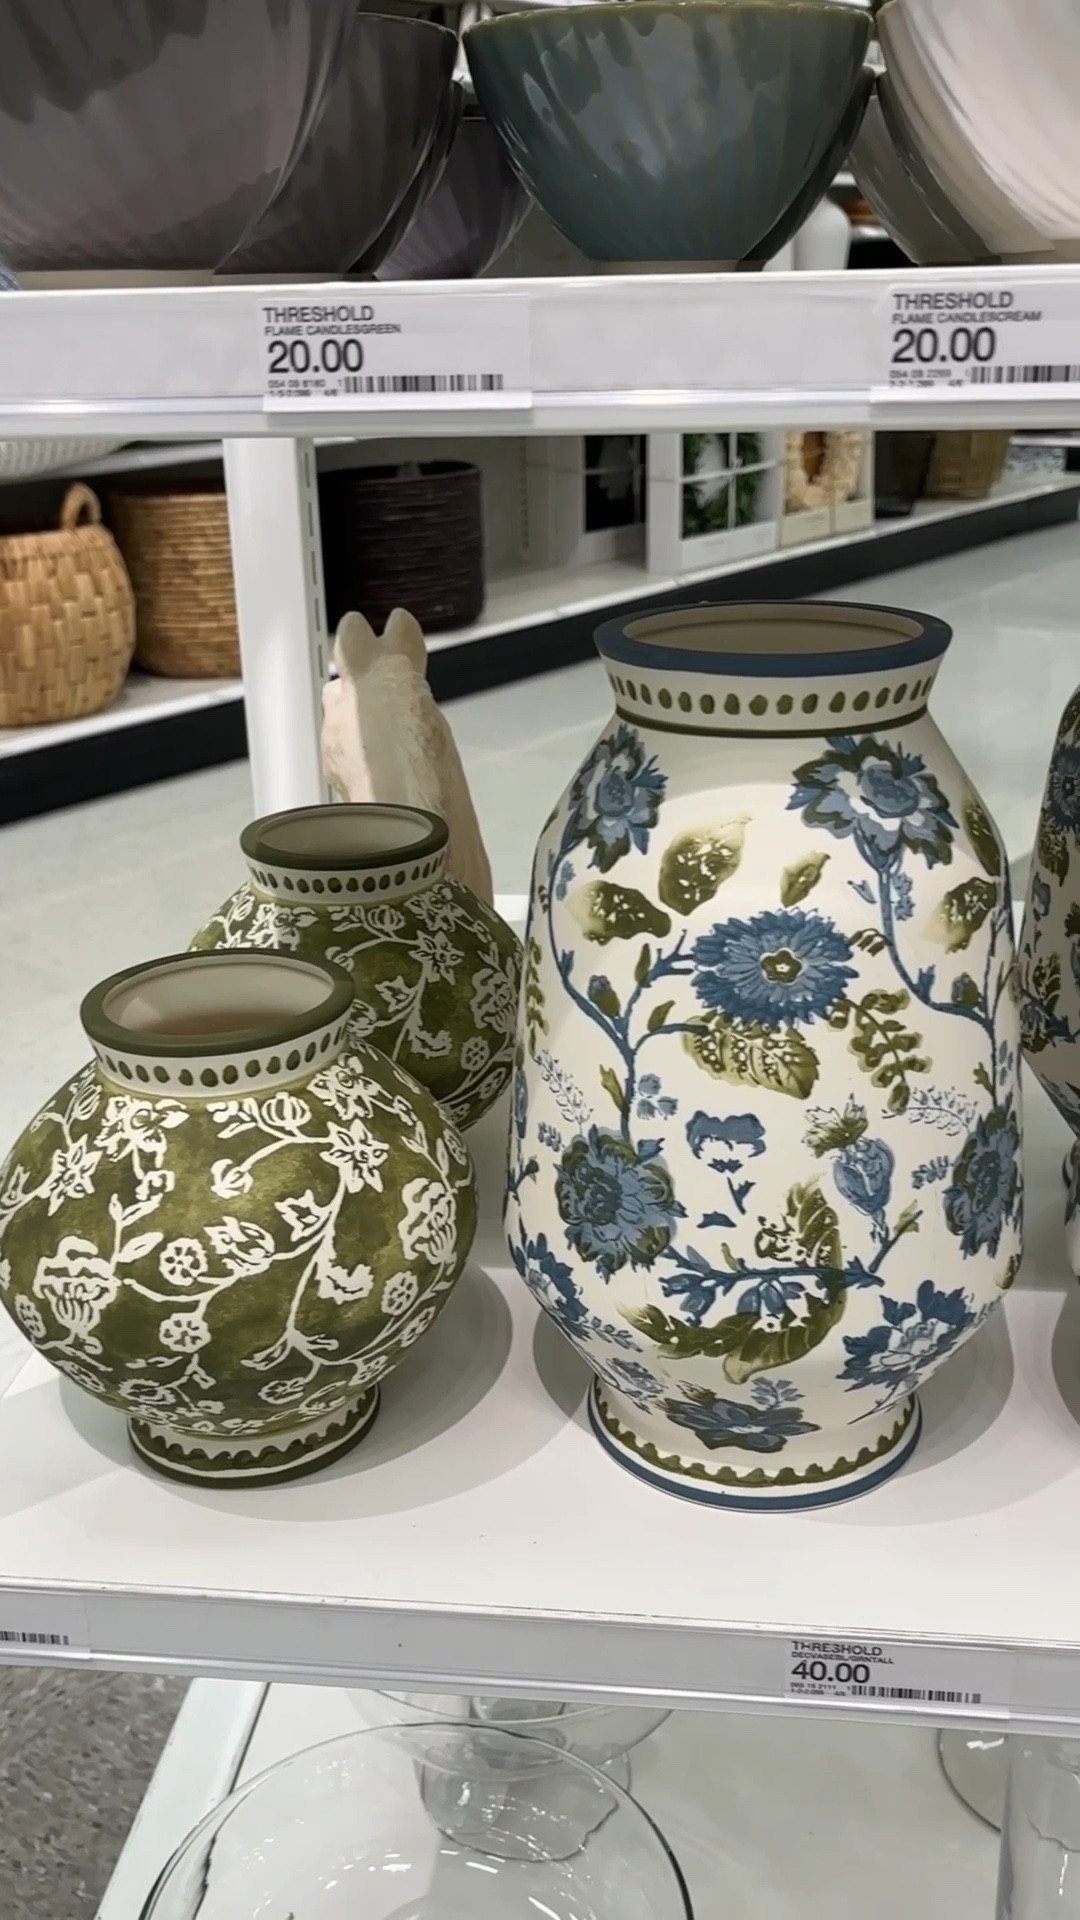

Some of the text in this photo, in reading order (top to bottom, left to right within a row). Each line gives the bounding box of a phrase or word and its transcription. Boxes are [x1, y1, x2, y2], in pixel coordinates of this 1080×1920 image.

[892, 291, 1013, 310] THRESHOLD
[262, 305, 374, 323] THRESHOLD
[892, 313, 934, 324] FLAME
[264, 323, 402, 336] FLAME CANDLESGREEN
[891, 327, 996, 363] 20.00
[268, 338, 364, 374] 20.00
[791, 1640, 883, 1656] THRESHOLD
[791, 1660, 870, 1684] 40.00
